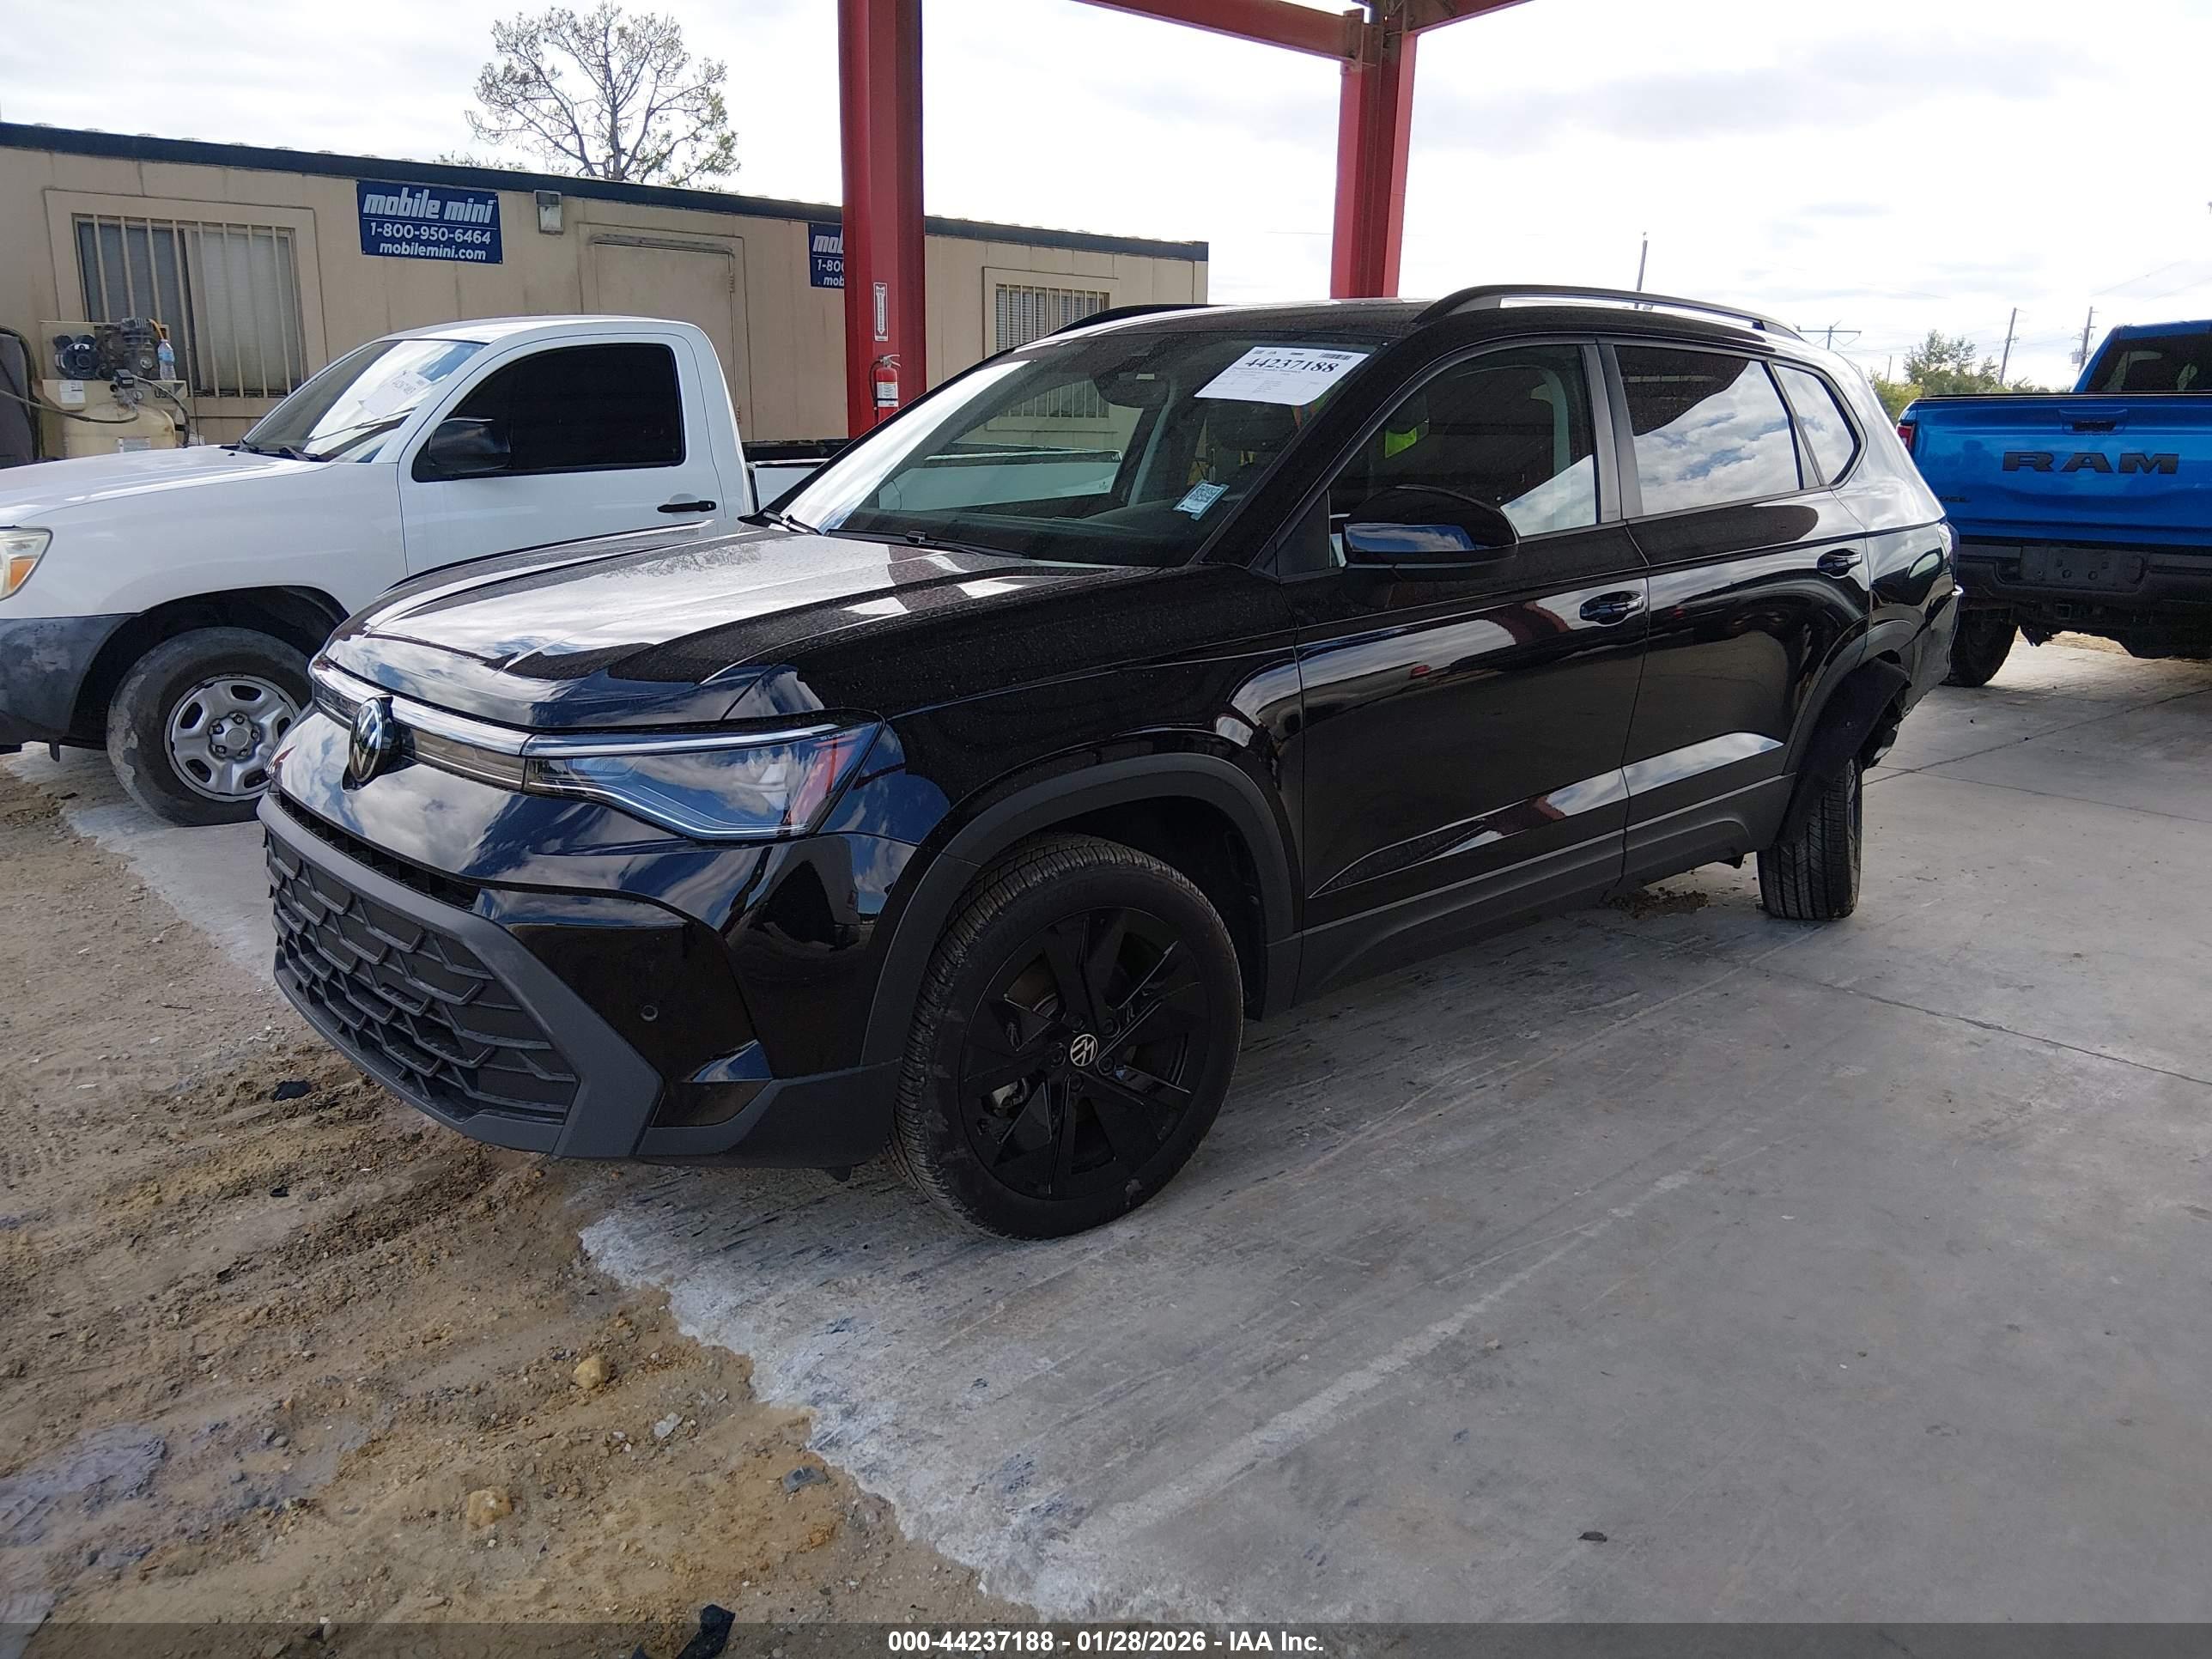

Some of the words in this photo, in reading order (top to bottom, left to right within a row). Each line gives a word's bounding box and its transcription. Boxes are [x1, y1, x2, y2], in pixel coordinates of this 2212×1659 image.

[362, 187, 441, 219] mobile
[443, 198, 495, 224] mini
[370, 222, 491, 245] 1-800-950-6464
[379, 241, 487, 260] mobilemini.com
[1244, 357, 1340, 373] 44237188
[2002, 451, 2179, 475] RAM
